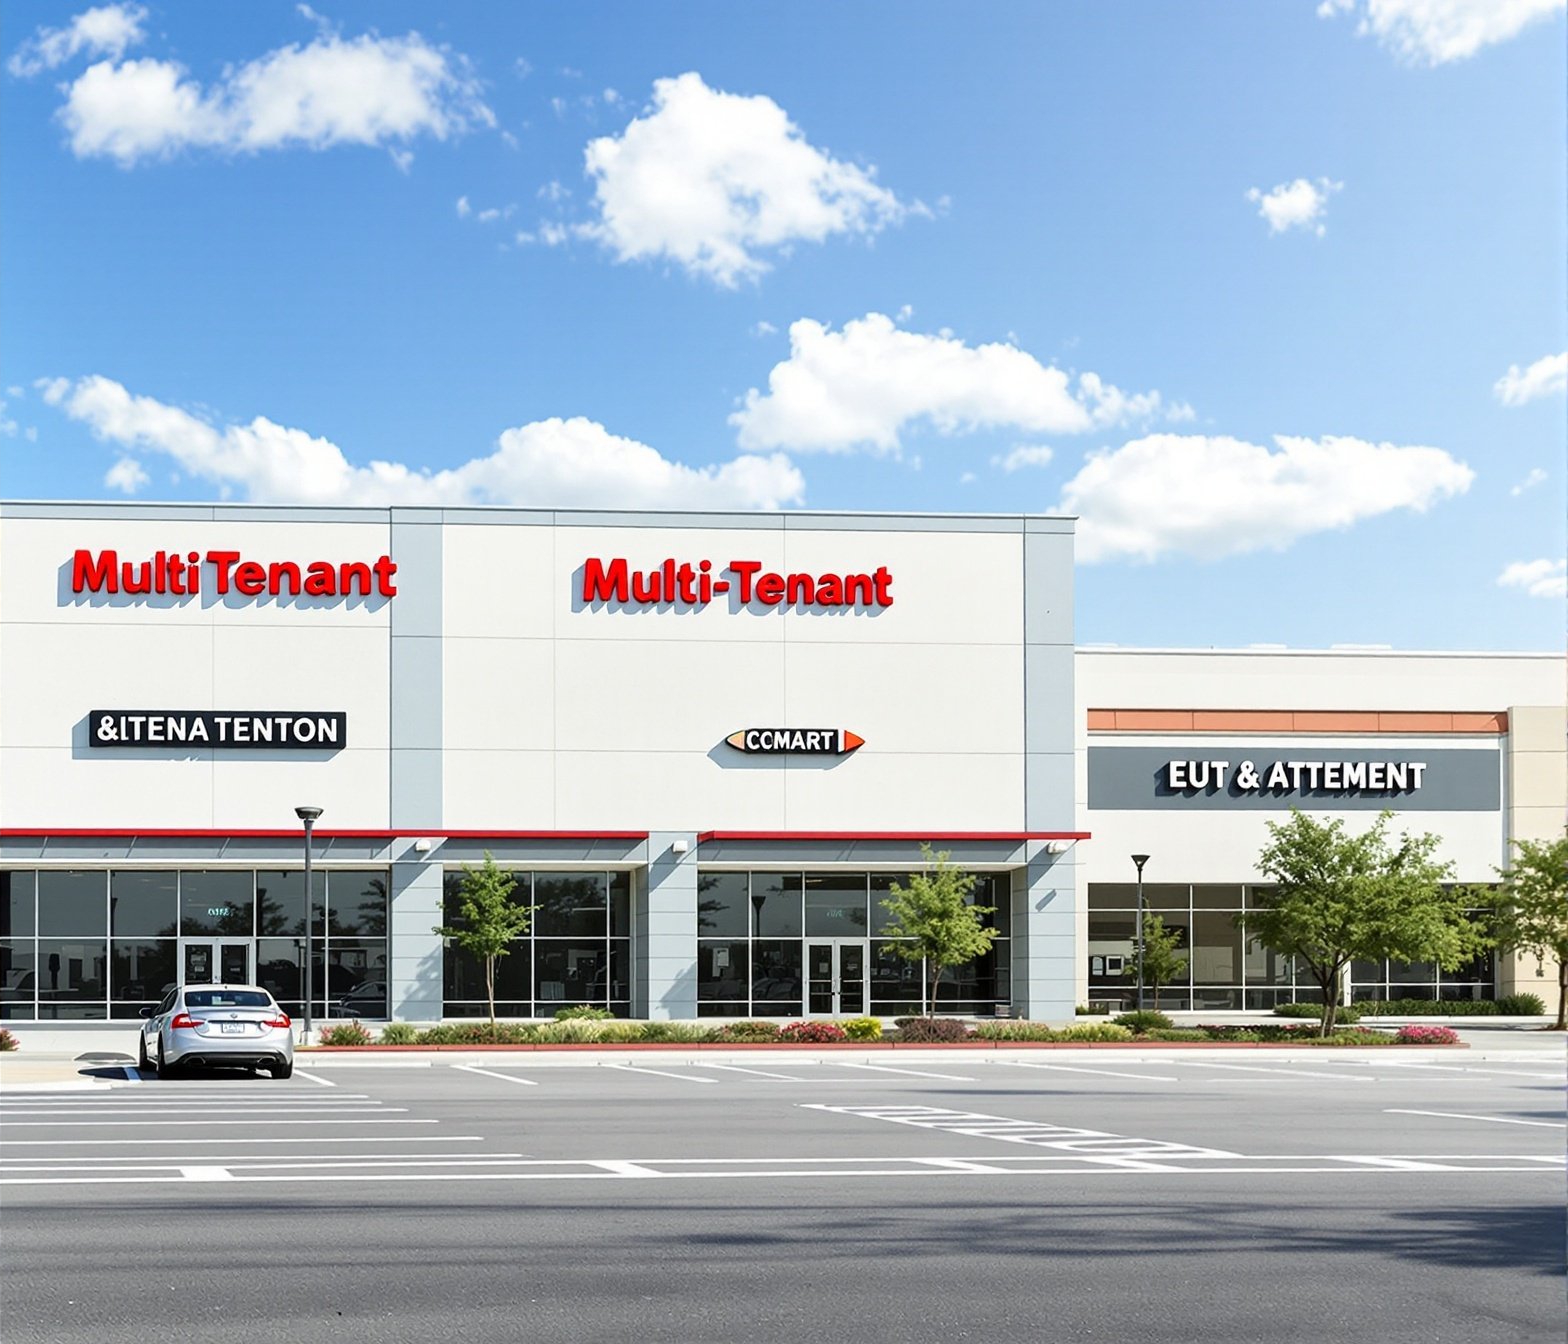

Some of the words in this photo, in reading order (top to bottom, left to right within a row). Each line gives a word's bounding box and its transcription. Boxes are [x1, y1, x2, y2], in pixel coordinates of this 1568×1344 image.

[72, 549, 199, 595] Multi
[206, 551, 397, 597] Tenant
[583, 557, 894, 606] Multi-Tenant
[214, 716, 338, 743] TENTON
[1169, 760, 1229, 789] EUT
[1237, 760, 1260, 790] &
[1267, 761, 1427, 790] ATTEMENT
